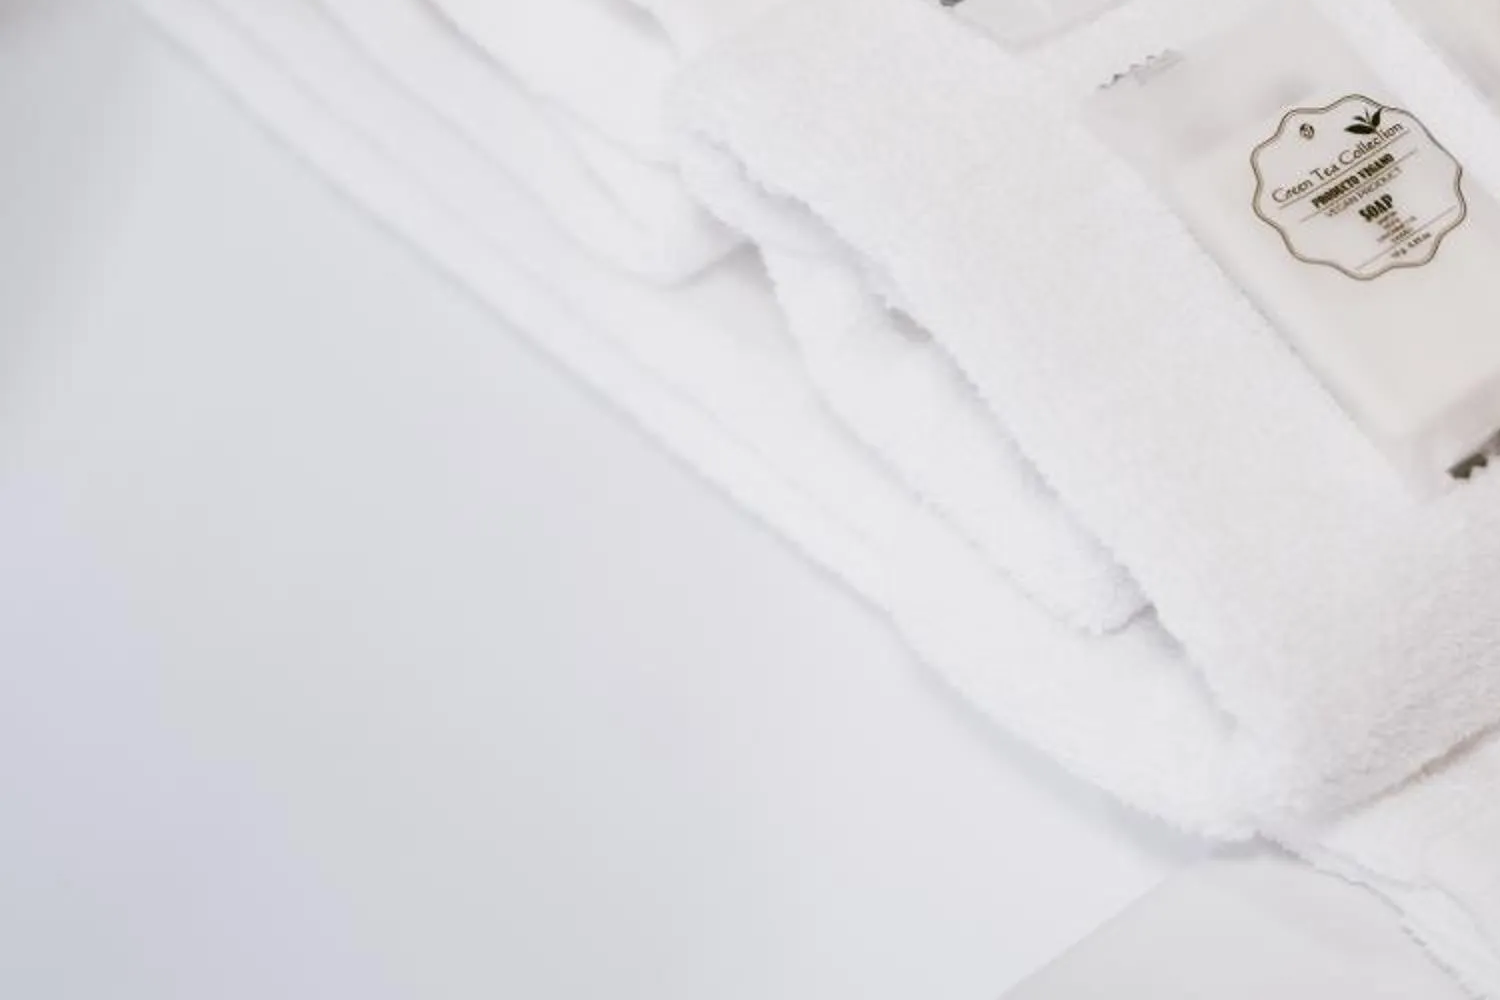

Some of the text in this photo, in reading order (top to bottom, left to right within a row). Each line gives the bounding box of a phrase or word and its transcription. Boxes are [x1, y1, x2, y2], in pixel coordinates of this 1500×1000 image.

[1272, 121, 1405, 203] Green Tea Collection
[1358, 193, 1394, 222] SOAP
